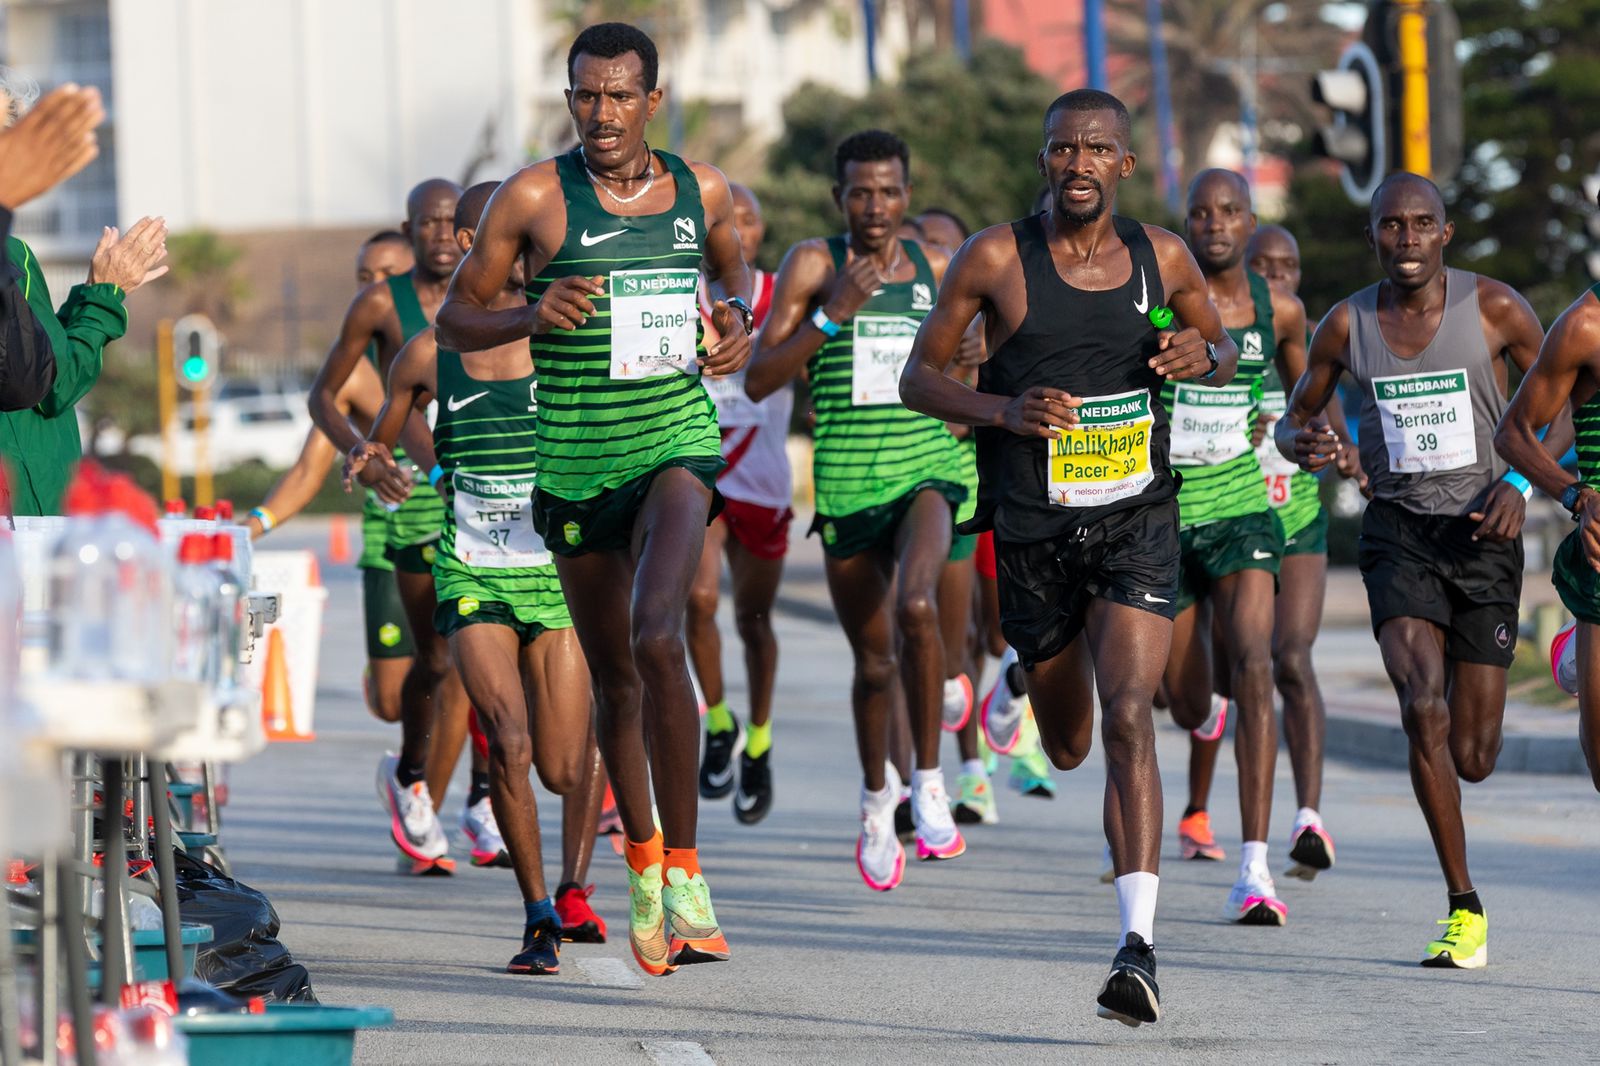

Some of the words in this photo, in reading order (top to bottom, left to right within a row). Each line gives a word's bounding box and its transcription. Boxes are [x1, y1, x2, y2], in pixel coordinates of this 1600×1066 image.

[641, 277, 694, 290] NEDBANK
[660, 336, 670, 356] 6
[1398, 378, 1458, 394] NEDBANK
[1200, 392, 1249, 404] NEDBANK
[1081, 400, 1142, 418] NEDBANK
[1393, 407, 1457, 429] Bernard
[1057, 430, 1145, 456] Melikhaya
[1416, 433, 1438, 451] 39
[1063, 463, 1109, 478] Pacer
[1123, 458, 1136, 475] 32
[476, 482, 534, 495] NEDBANK
[1074, 488, 1103, 496] nelson
[1104, 481, 1135, 494] mandela
[1136, 475, 1151, 486] bay
[476, 510, 521, 522] TETE
[489, 528, 510, 546] 37
